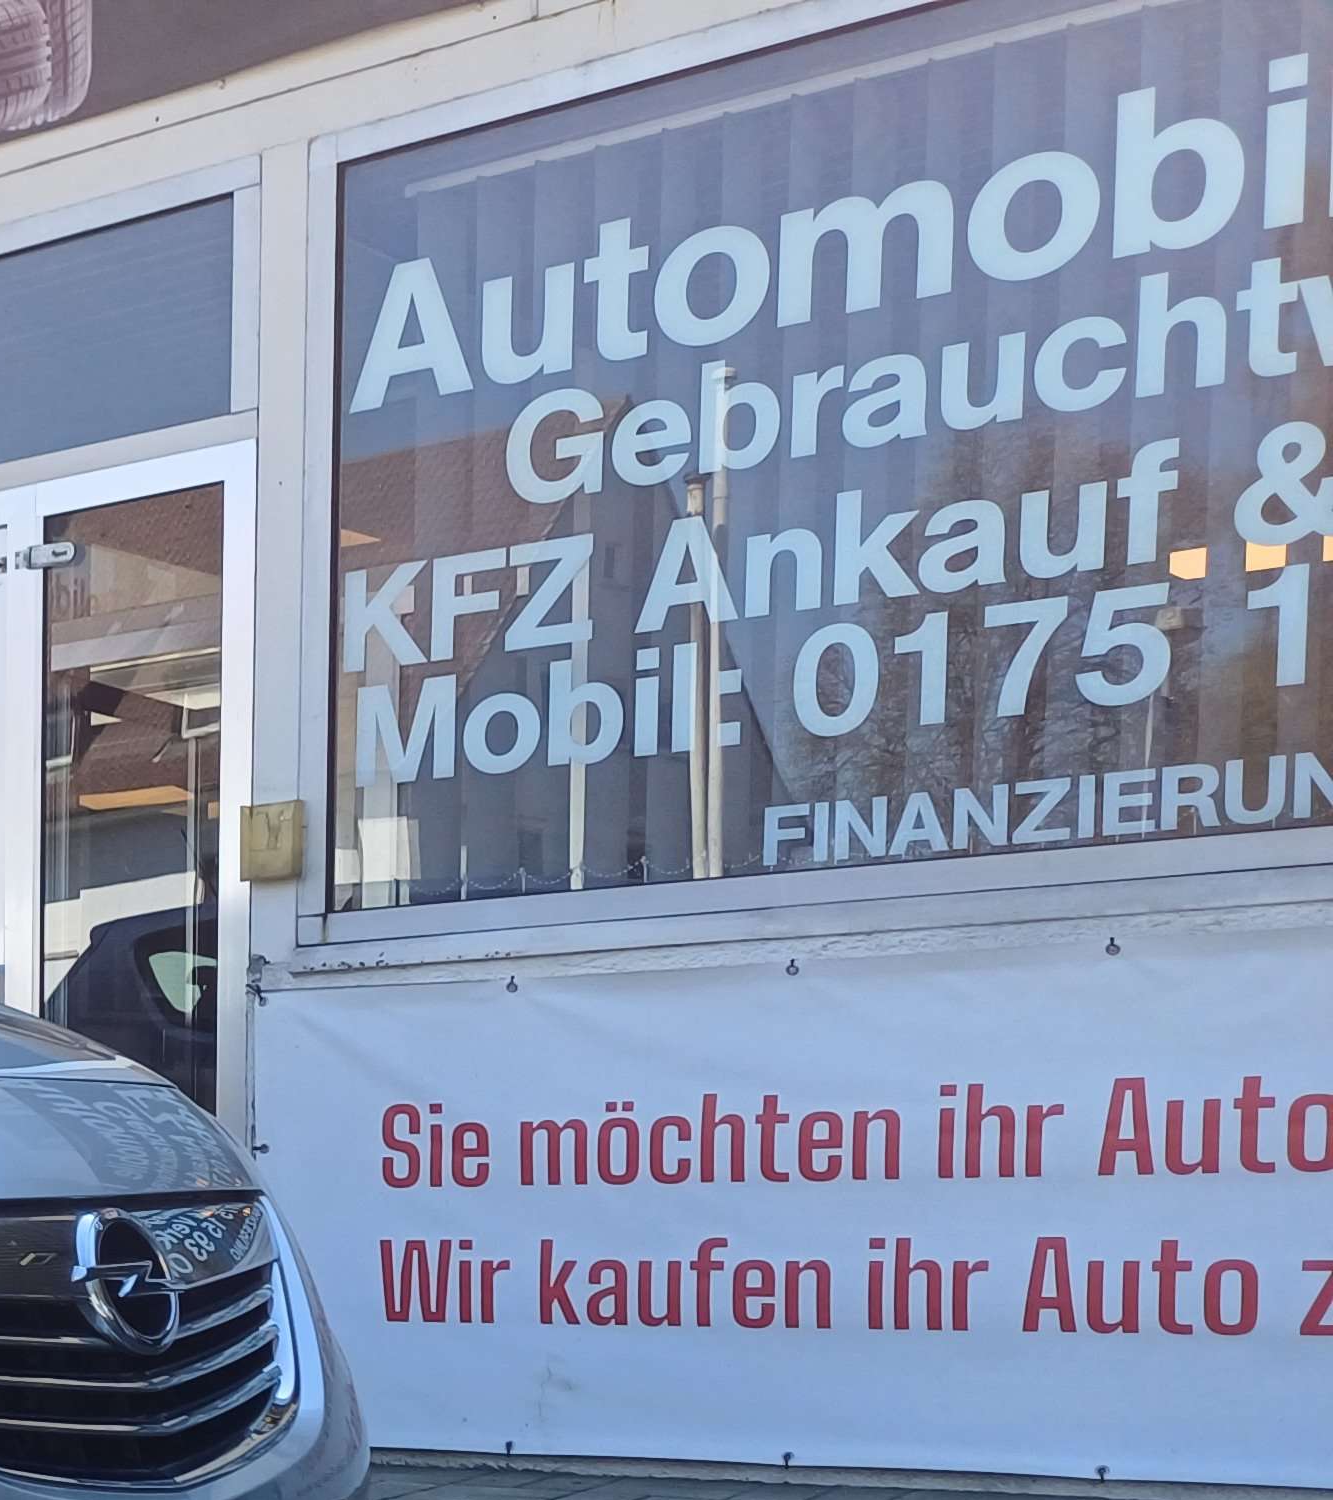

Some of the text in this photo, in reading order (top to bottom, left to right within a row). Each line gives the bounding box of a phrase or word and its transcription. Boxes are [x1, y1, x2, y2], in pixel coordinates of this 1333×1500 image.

[349, 53, 1333, 414] Automobi
[343, 421, 1333, 673] KFZ Ankauf &
[792, 582, 1172, 737] 0175
[1247, 564, 1306, 686] 1
[381, 1075, 1333, 1188] Sie möchten ihr Auto
[380, 1238, 510, 1324] Wir
[539, 1237, 832, 1329] kaufen
[867, 1237, 989, 1331] ihr
[1022, 1236, 1258, 1335] Auto
